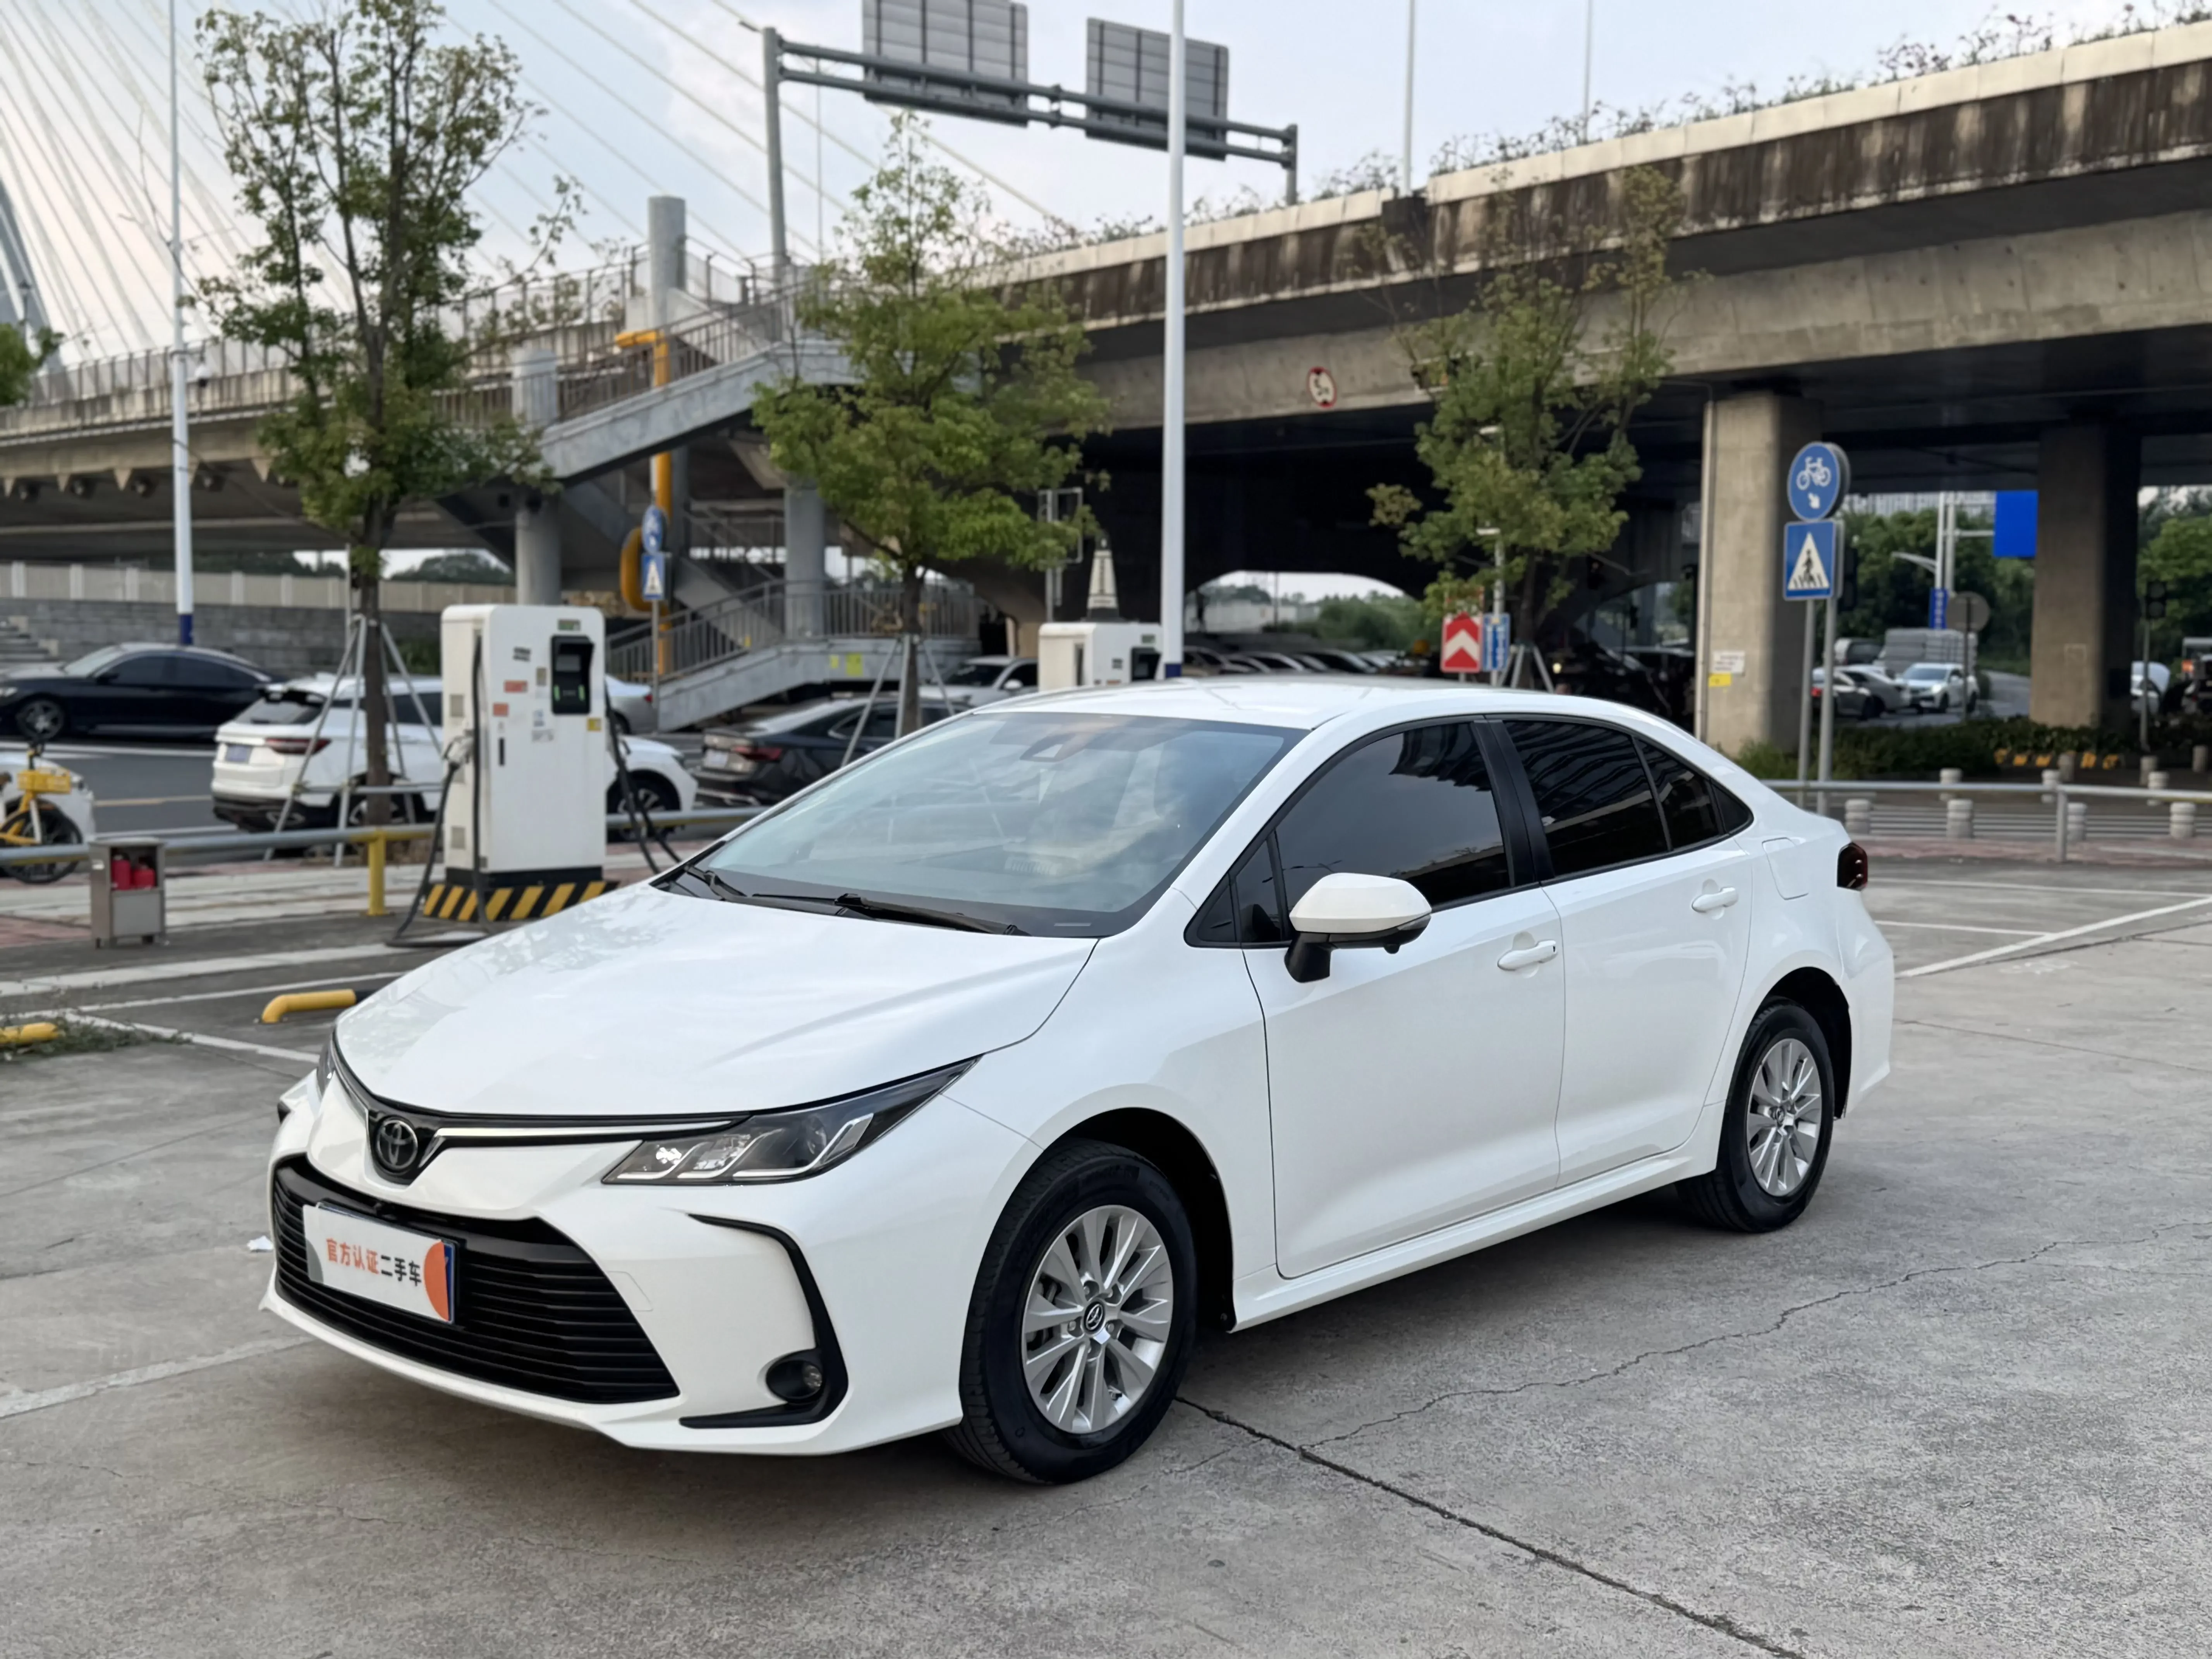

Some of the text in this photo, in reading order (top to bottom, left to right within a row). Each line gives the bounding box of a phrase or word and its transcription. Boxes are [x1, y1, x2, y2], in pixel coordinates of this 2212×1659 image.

[326, 1238, 422, 1286] 官方认证二手车
